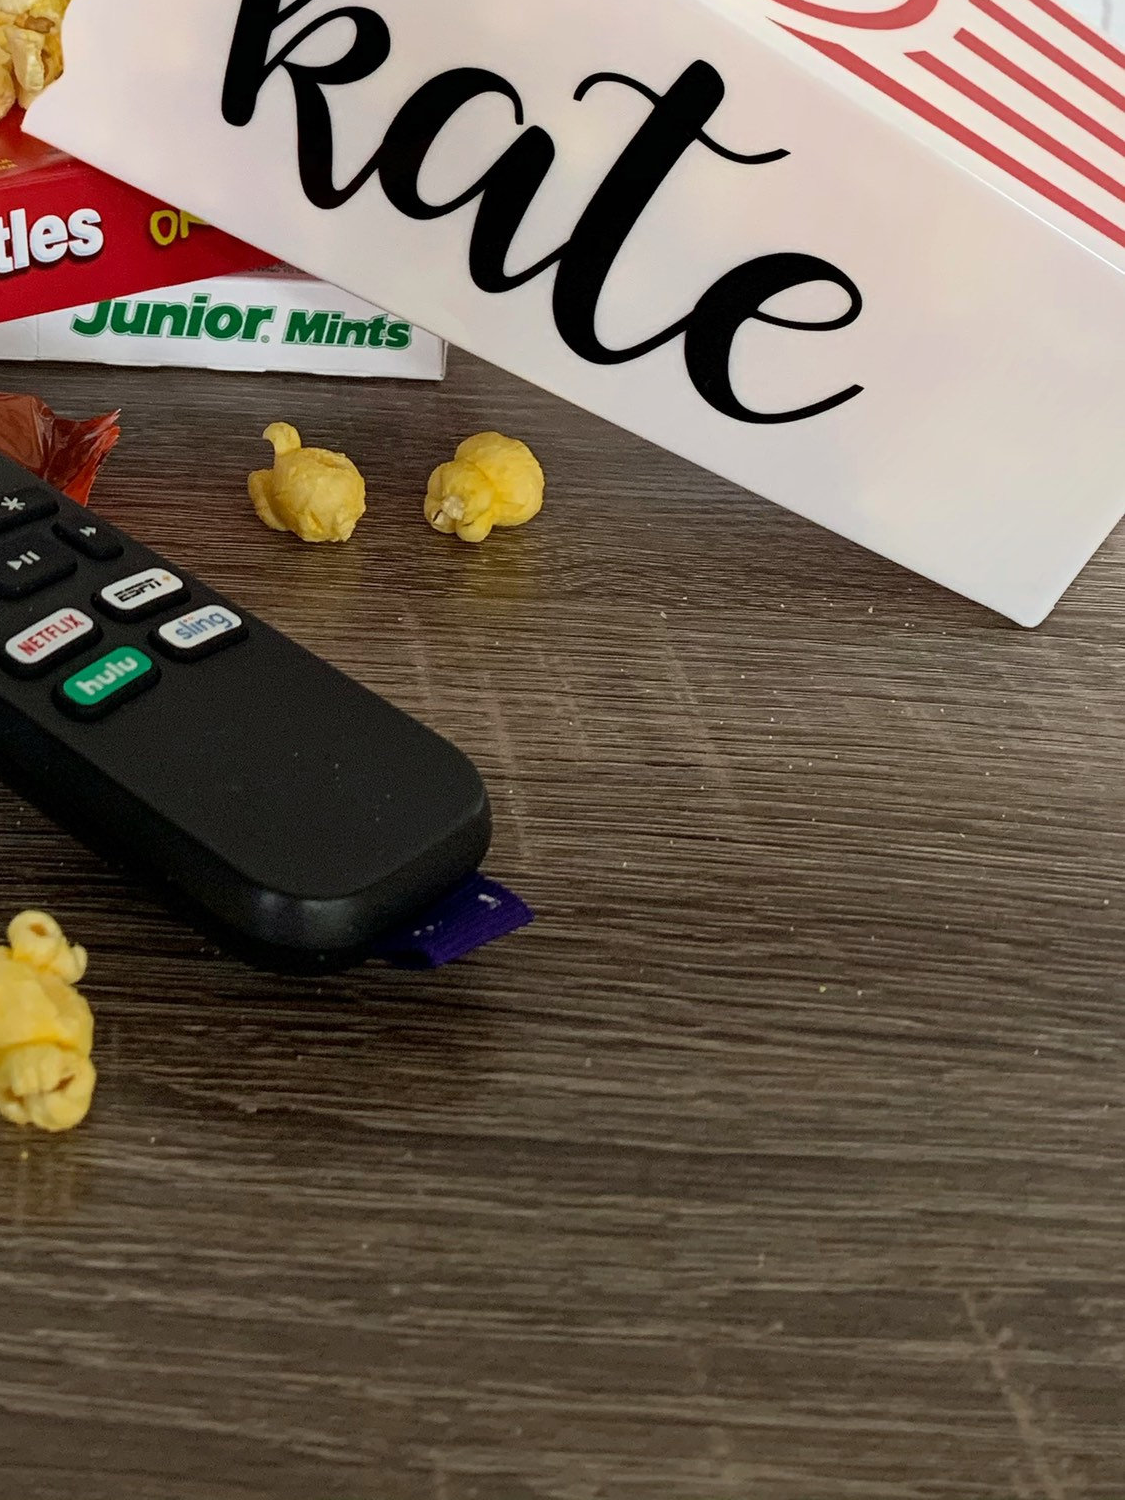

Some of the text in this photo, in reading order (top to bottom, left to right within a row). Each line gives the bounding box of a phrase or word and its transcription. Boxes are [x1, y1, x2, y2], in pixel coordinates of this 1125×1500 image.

[282, 309, 413, 349] Mints
[17, 613, 85, 657] NETFLIX
[175, 612, 233, 640] sling
[75, 656, 138, 696] hulu
